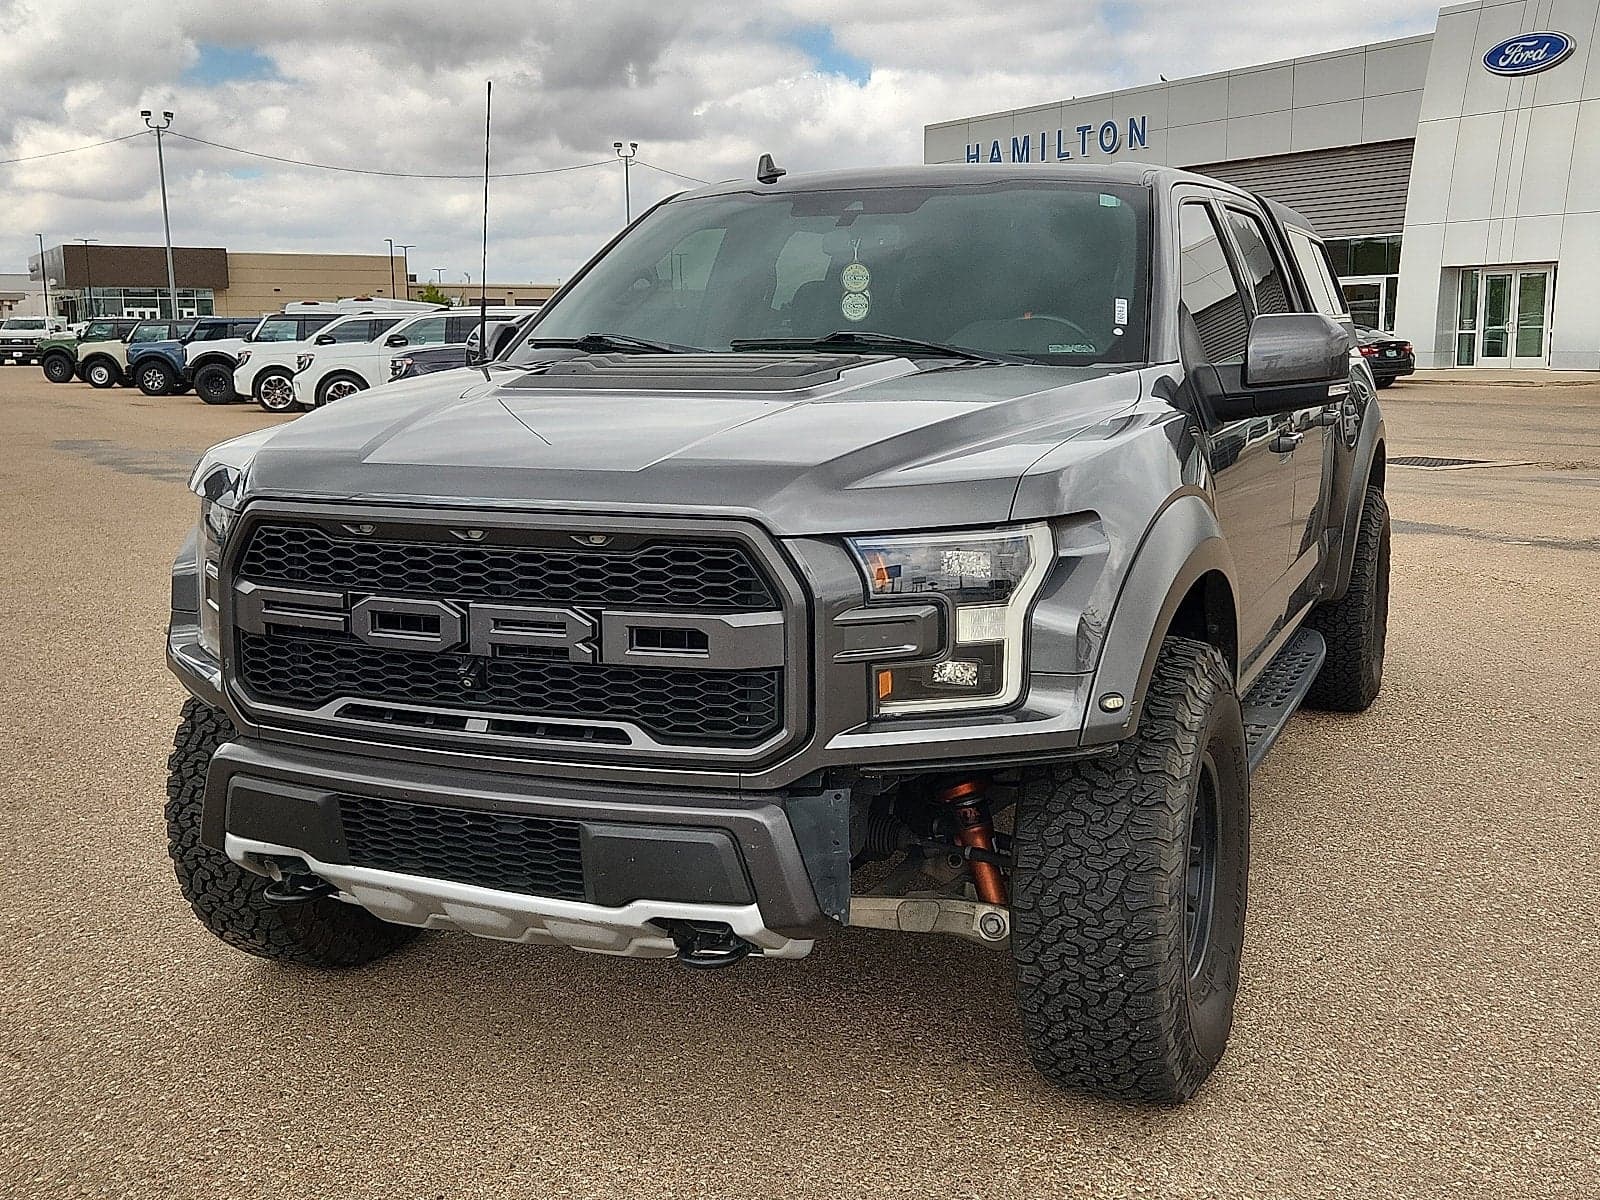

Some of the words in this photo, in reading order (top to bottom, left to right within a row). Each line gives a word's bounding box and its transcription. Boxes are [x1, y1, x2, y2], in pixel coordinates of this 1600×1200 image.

[1498, 40, 1551, 67] Ford
[965, 115, 1148, 163] HAMILTON
[234, 577, 785, 669] FORD
